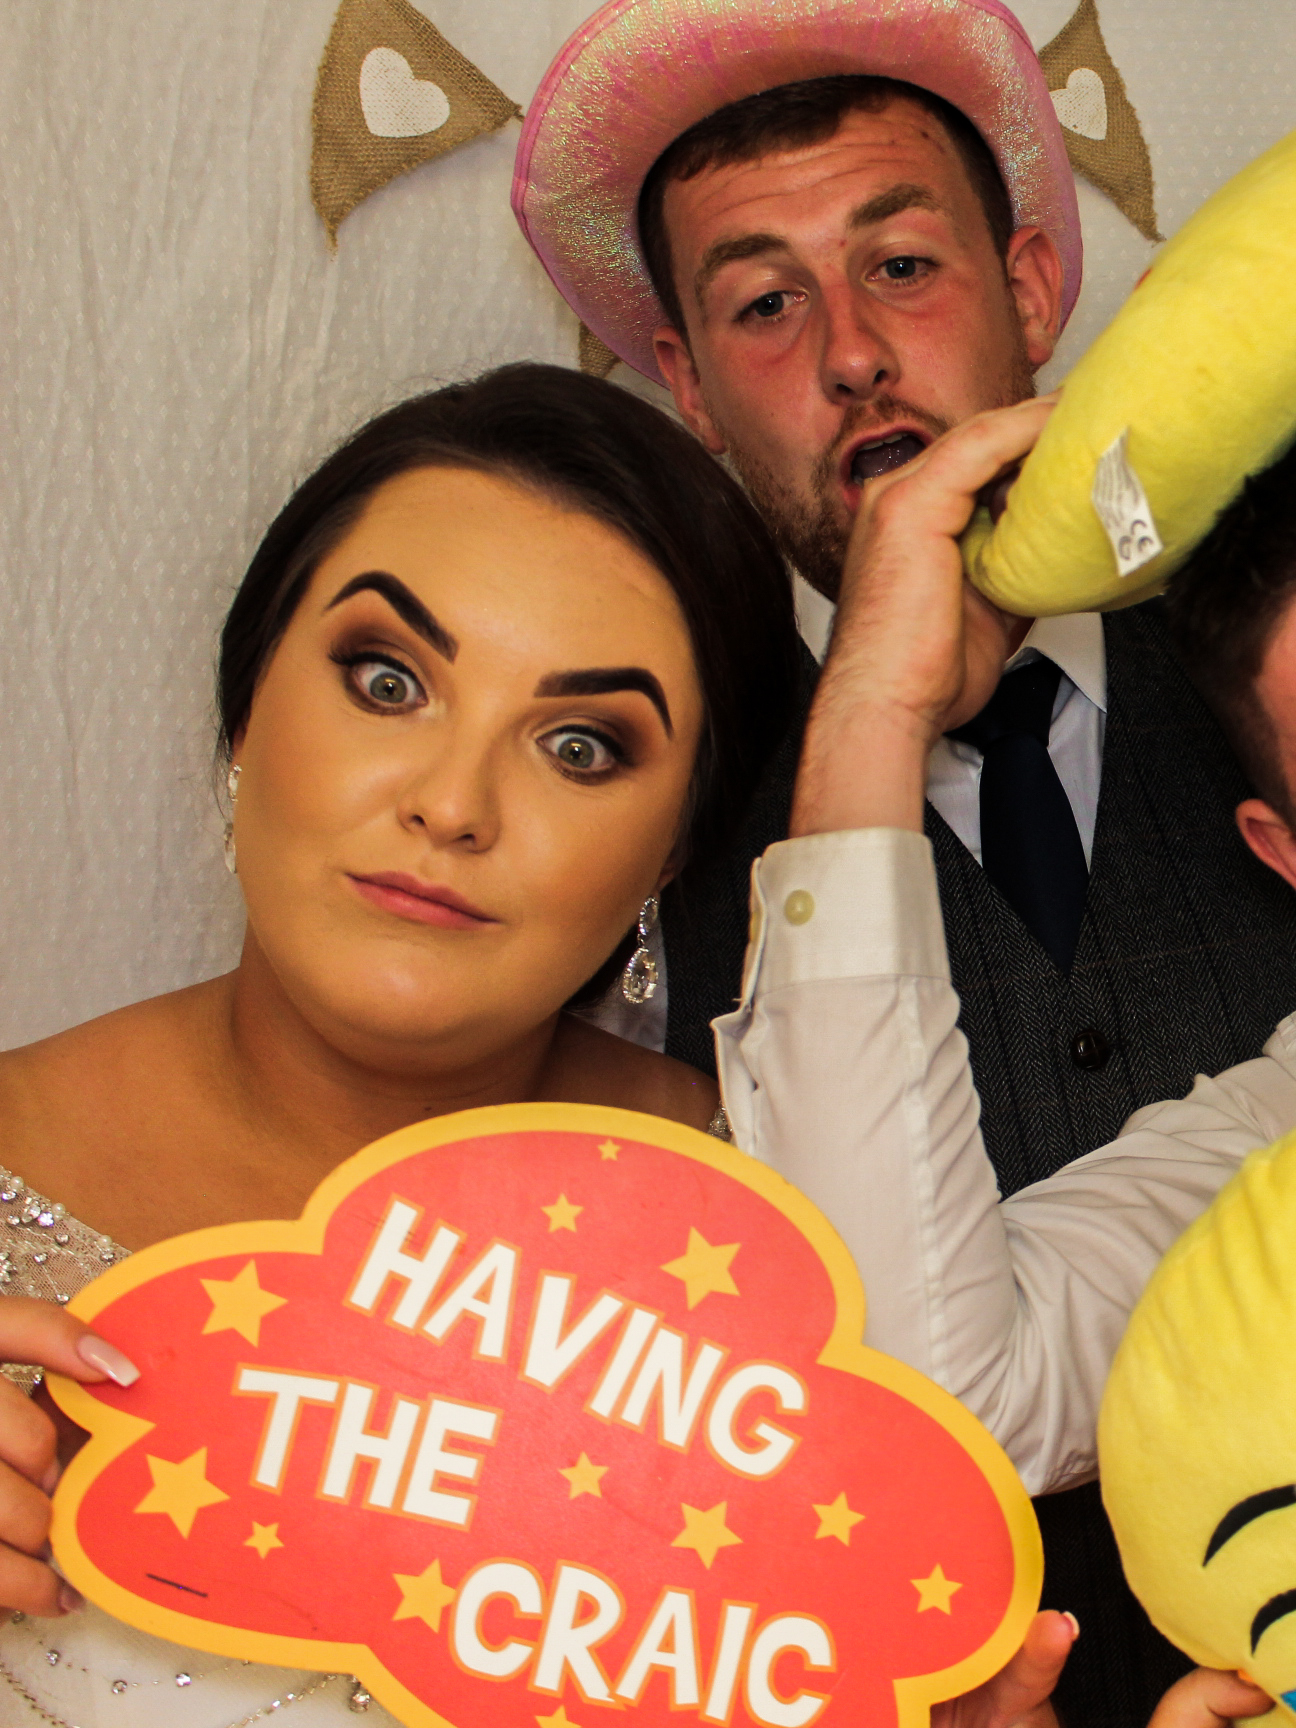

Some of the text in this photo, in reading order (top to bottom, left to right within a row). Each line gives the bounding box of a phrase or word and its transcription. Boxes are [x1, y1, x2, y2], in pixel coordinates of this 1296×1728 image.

[347, 1197, 807, 1478] HAVING
[236, 1367, 498, 1527] THE
[452, 1560, 834, 1728] CRAIC
